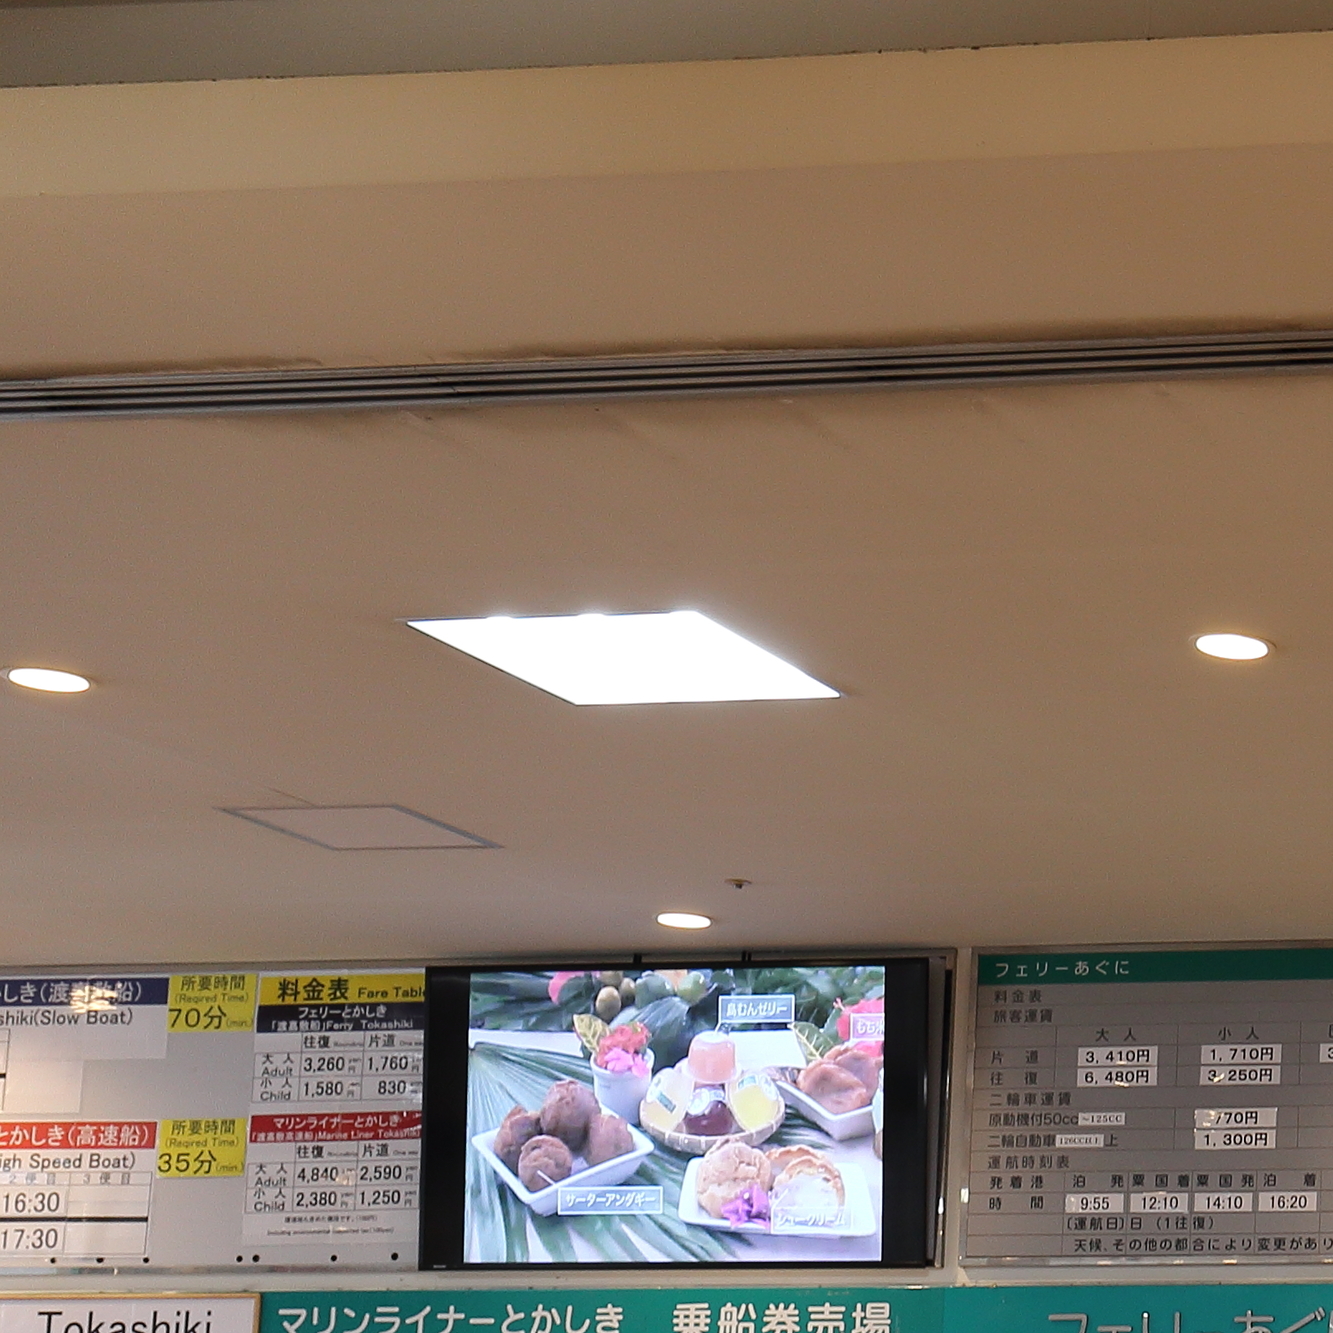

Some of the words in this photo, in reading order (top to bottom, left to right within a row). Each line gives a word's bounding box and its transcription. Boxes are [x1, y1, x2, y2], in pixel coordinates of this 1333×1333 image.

[995, 959, 1130, 979] フェリーあぐに
[181, 975, 245, 992] 所要時間
[277, 977, 349, 1002] 料金表
[357, 987, 388, 999] Fare
[86, 1009, 133, 1026] Boat)
[168, 1006, 226, 1030] 70分
[298, 1005, 388, 1019] フェリーとかしき
[304, 1035, 331, 1049] 往復
[367, 1034, 397, 1048] 片道
[1085, 1049, 1151, 1064] 3,410円
[1210, 1047, 1274, 1062] 1,710円
[261, 1067, 294, 1078] Adult
[303, 1057, 345, 1073] 3,260
[368, 1056, 409, 1072] 1,760
[1085, 1070, 1149, 1085] 6,480円
[260, 1091, 291, 1101] Child
[303, 1081, 344, 1098] 1,580
[378, 1080, 407, 1095] 830
[171, 1119, 236, 1136] 所要時間
[273, 1113, 401, 1130] マリンライナーとかしき
[1203, 1132, 1268, 1148] 1,300円
[29, 1153, 83, 1172] Speed
[86, 1151, 136, 1170] Boat)
[157, 1150, 216, 1174] 35分
[297, 1167, 339, 1183] 4,840
[360, 1165, 402, 1182] 2,590
[2, 1191, 60, 1214] 16:30
[296, 1191, 337, 1208] 2,380
[360, 1190, 401, 1206] 1,250
[1080, 1197, 1110, 1210] 9:55
[1141, 1196, 1179, 1210] 12:10
[1205, 1195, 1244, 1210] 14:10
[1270, 1193, 1308, 1209] 16:20
[1, 1228, 58, 1251] 17:30
